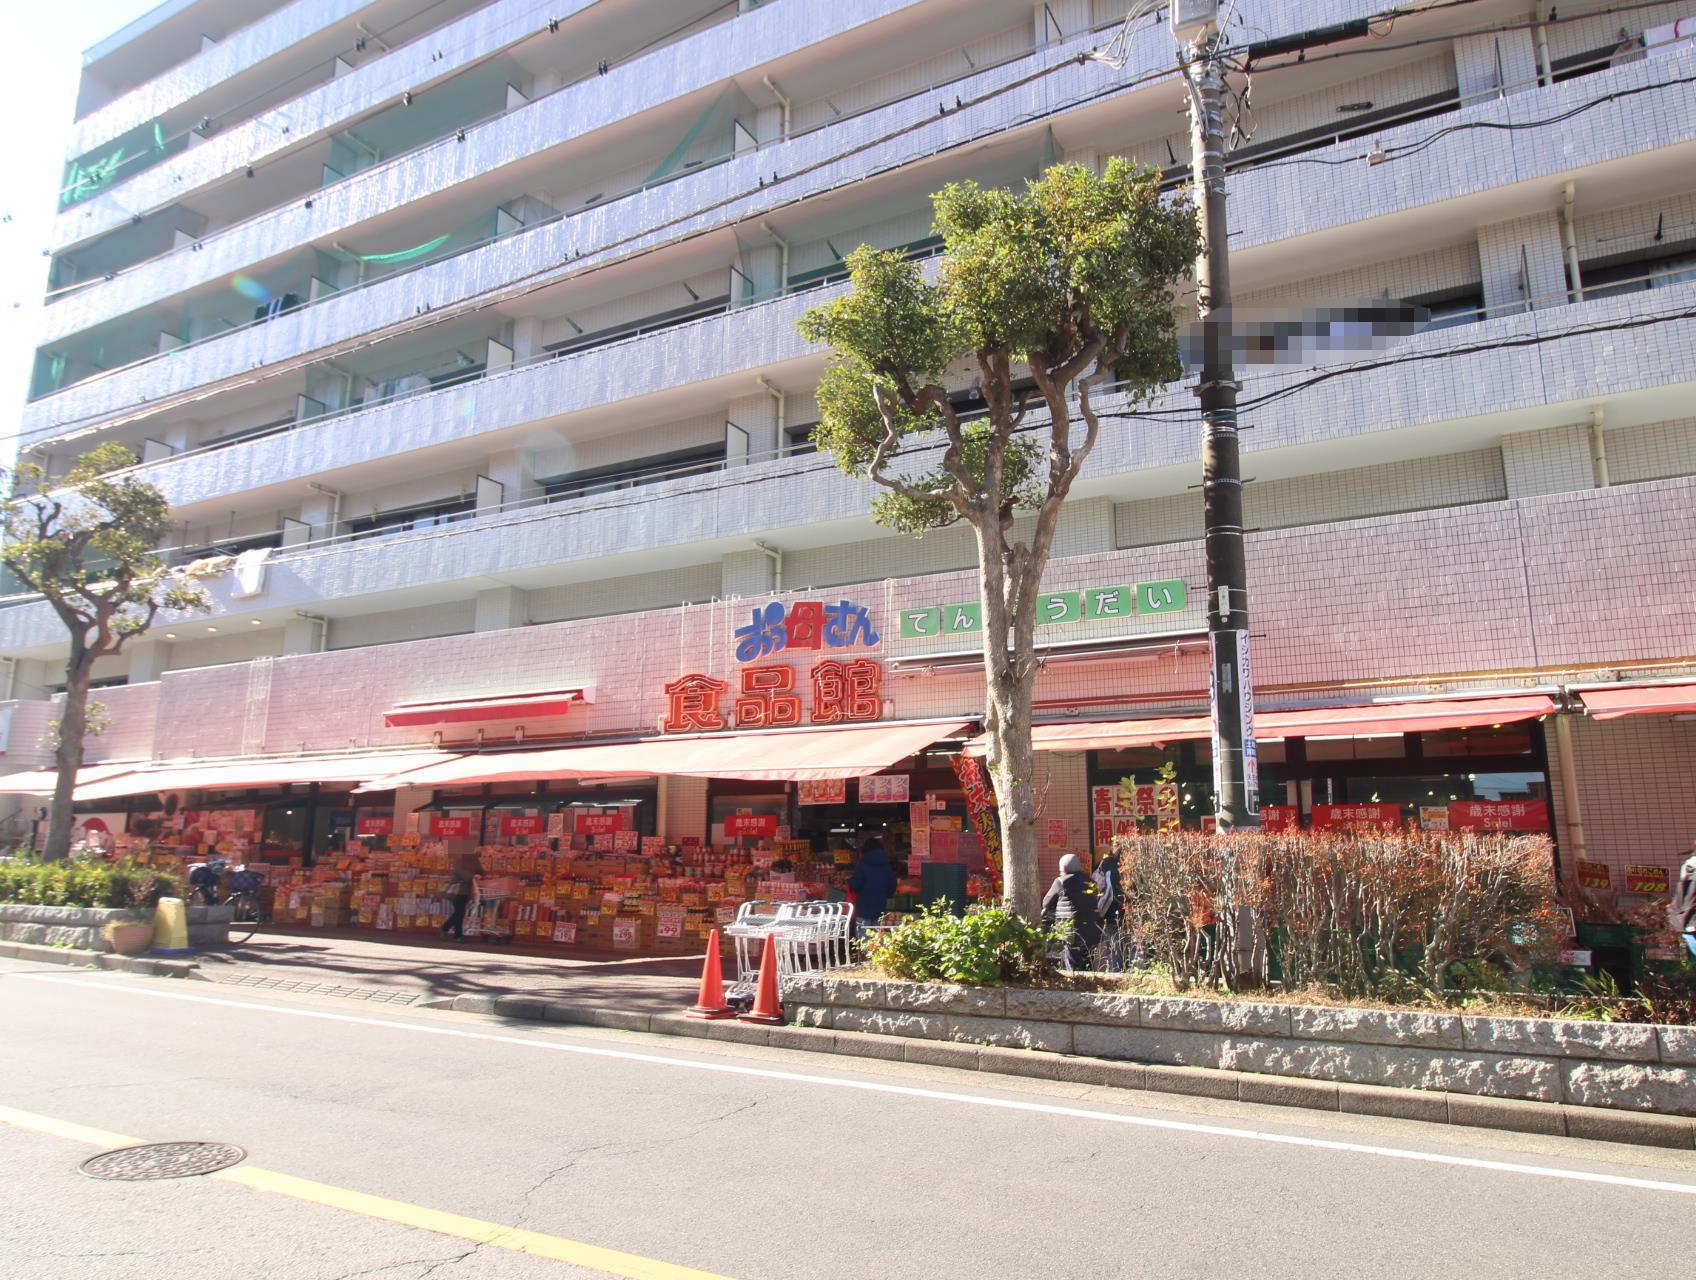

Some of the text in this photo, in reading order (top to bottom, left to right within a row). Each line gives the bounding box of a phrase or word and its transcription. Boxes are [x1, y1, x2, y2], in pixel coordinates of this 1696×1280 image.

[908, 587, 1173, 633] てんうだい
[664, 659, 882, 734] 食品館
[1330, 807, 1381, 820] 歳末感謝
[1469, 804, 1526, 817] 歳末感謝
